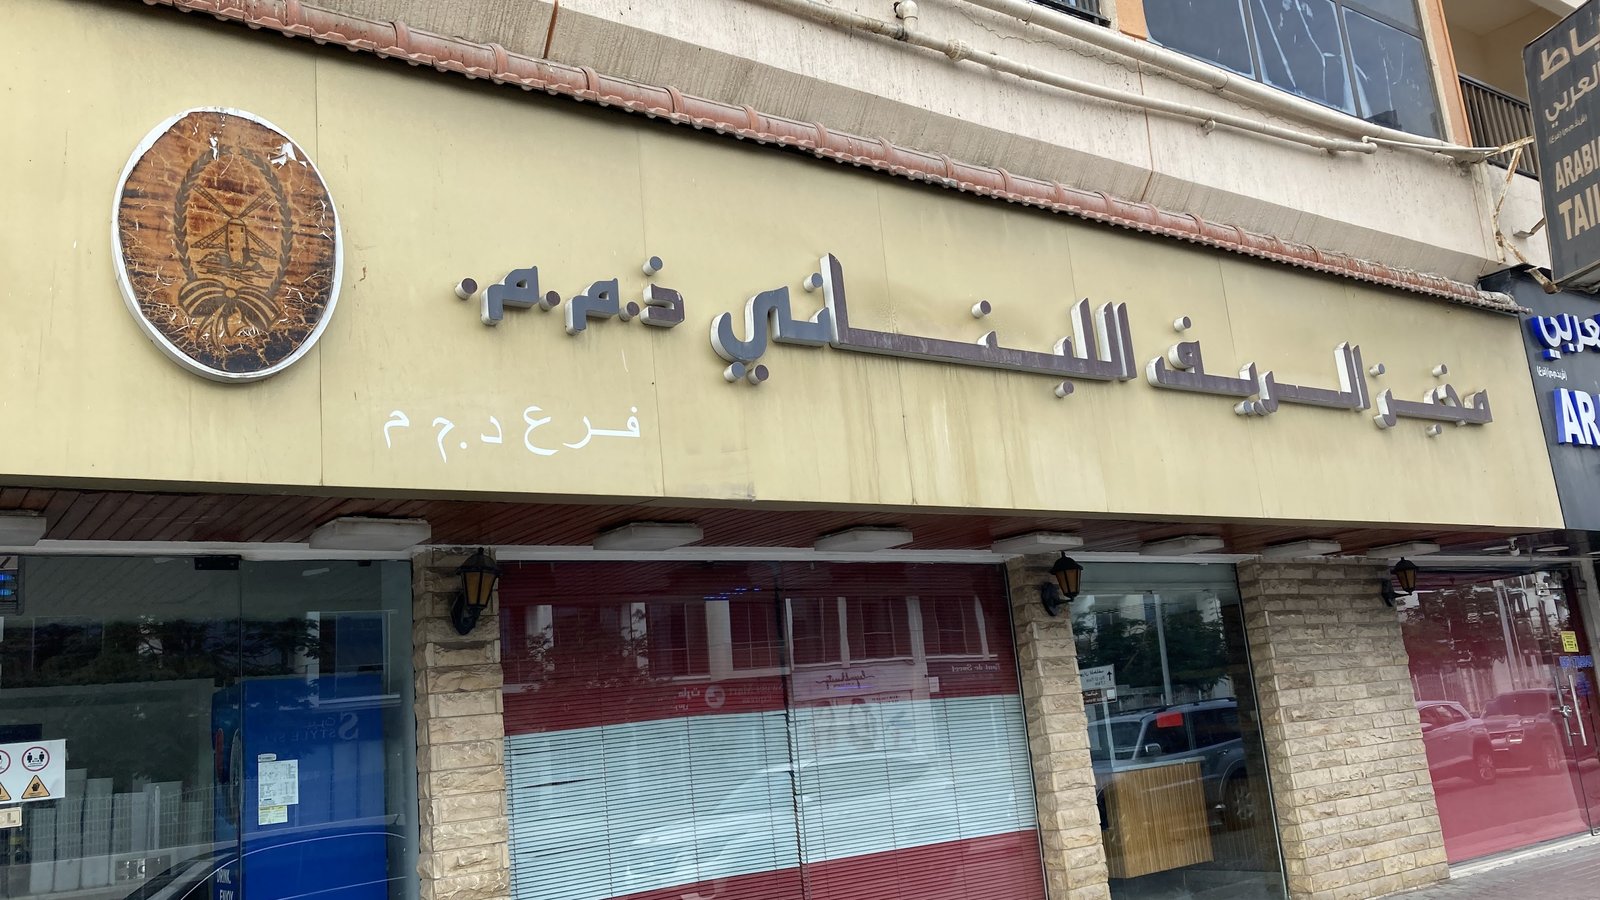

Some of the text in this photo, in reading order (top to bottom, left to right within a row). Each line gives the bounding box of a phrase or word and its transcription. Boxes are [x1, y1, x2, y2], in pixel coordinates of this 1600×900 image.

[1555, 136, 1600, 193] ARABI
[710, 252, 1138, 398] اللبناني
[1527, 313, 1600, 361] عربي
[1146, 315, 1372, 417] الريف
[522, 405, 641, 456] فرع
[1370, 363, 1494, 438] مخبز
[1555, 387, 1600, 447] AR
